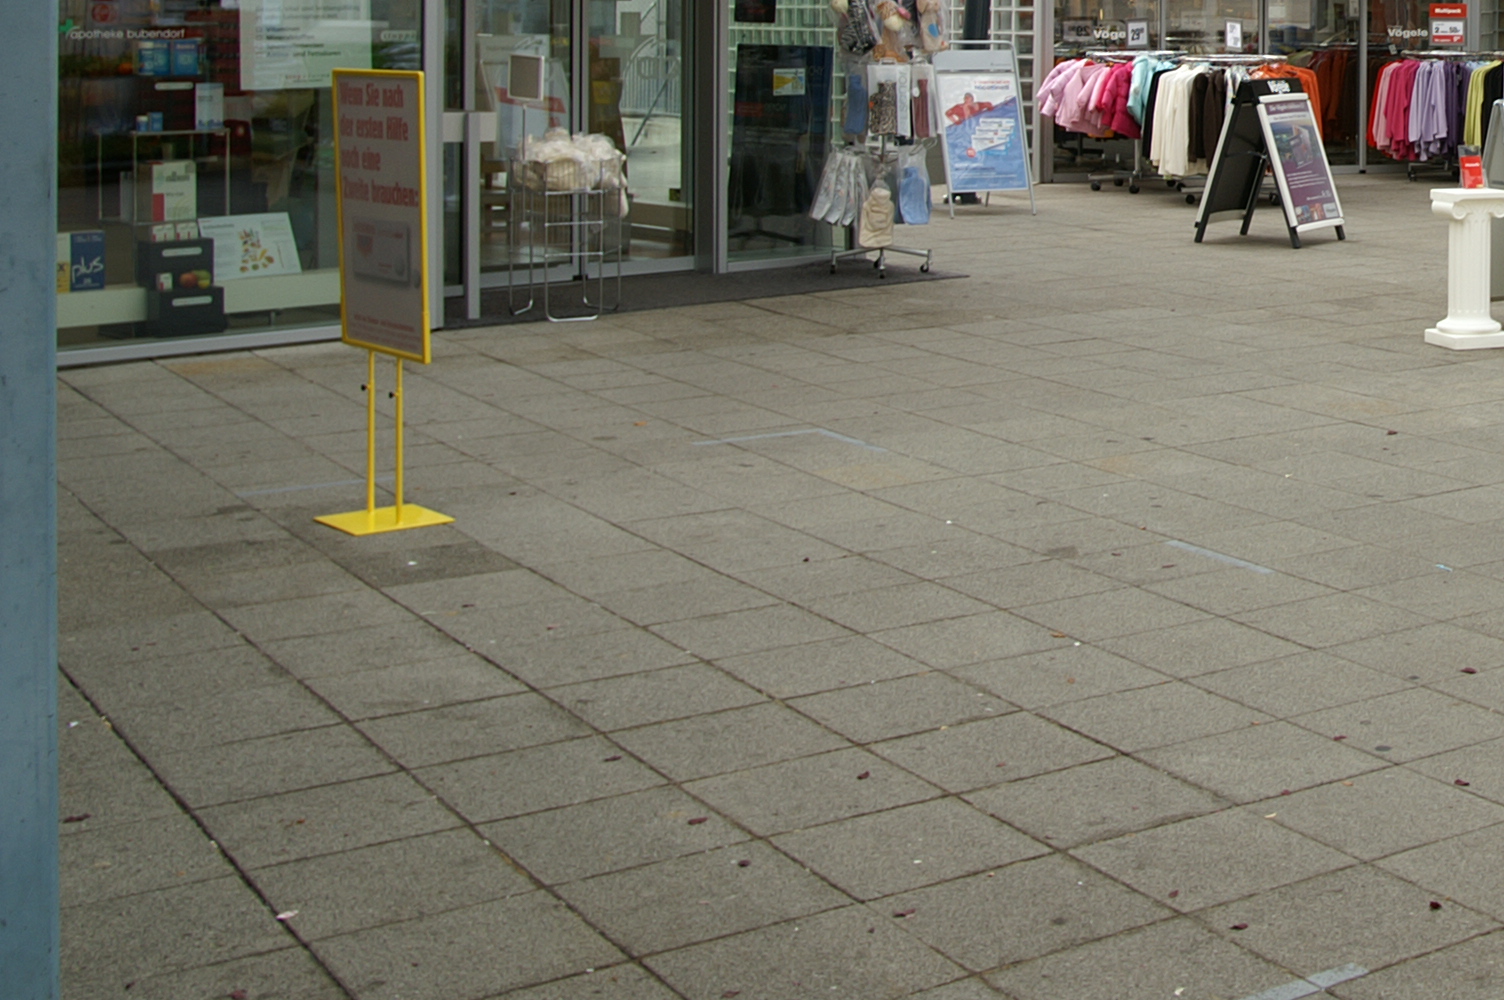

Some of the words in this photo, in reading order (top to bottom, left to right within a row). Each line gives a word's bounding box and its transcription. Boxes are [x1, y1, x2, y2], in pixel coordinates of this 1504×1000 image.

[70, 28, 124, 40] apotheke
[126, 28, 185, 39] bubendorf
[365, 82, 380, 107] Sie
[72, 256, 103, 284] plus
